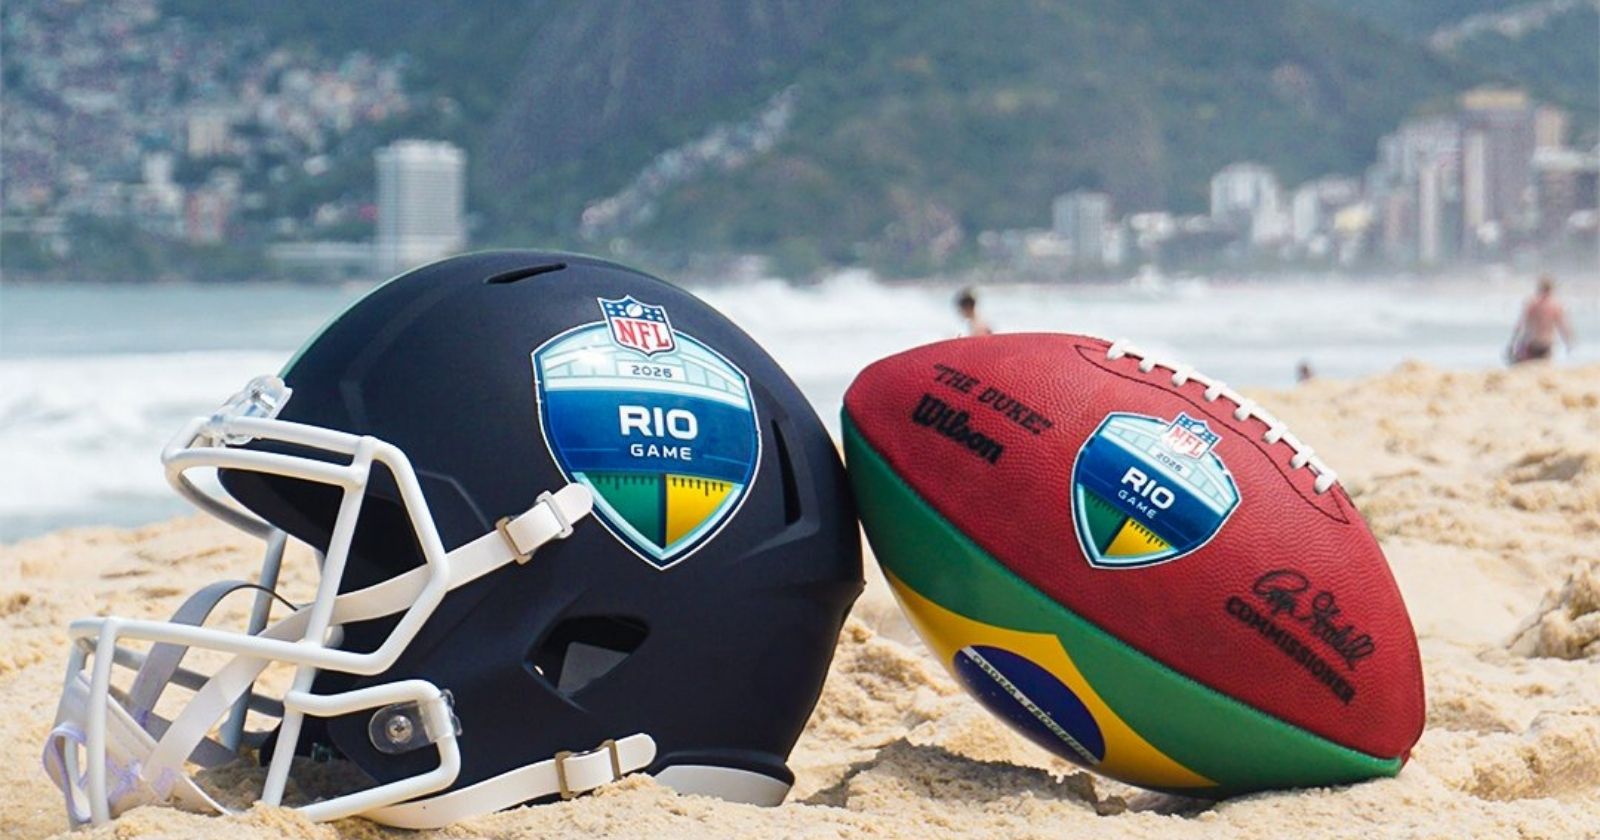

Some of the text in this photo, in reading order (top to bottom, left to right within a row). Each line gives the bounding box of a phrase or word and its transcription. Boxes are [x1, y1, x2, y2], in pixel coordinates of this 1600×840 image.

[615, 319, 670, 348] NFL
[631, 365, 673, 379] 2026
[618, 405, 698, 440] RIO
[912, 393, 1004, 464] Wilson
[630, 443, 692, 461] GAME
[1168, 426, 1204, 457] NFL
[1155, 452, 1184, 472] 2026
[1121, 466, 1175, 510] RIO
[1118, 490, 1157, 519] GAME
[1226, 595, 1355, 706] COMMISSIONER
